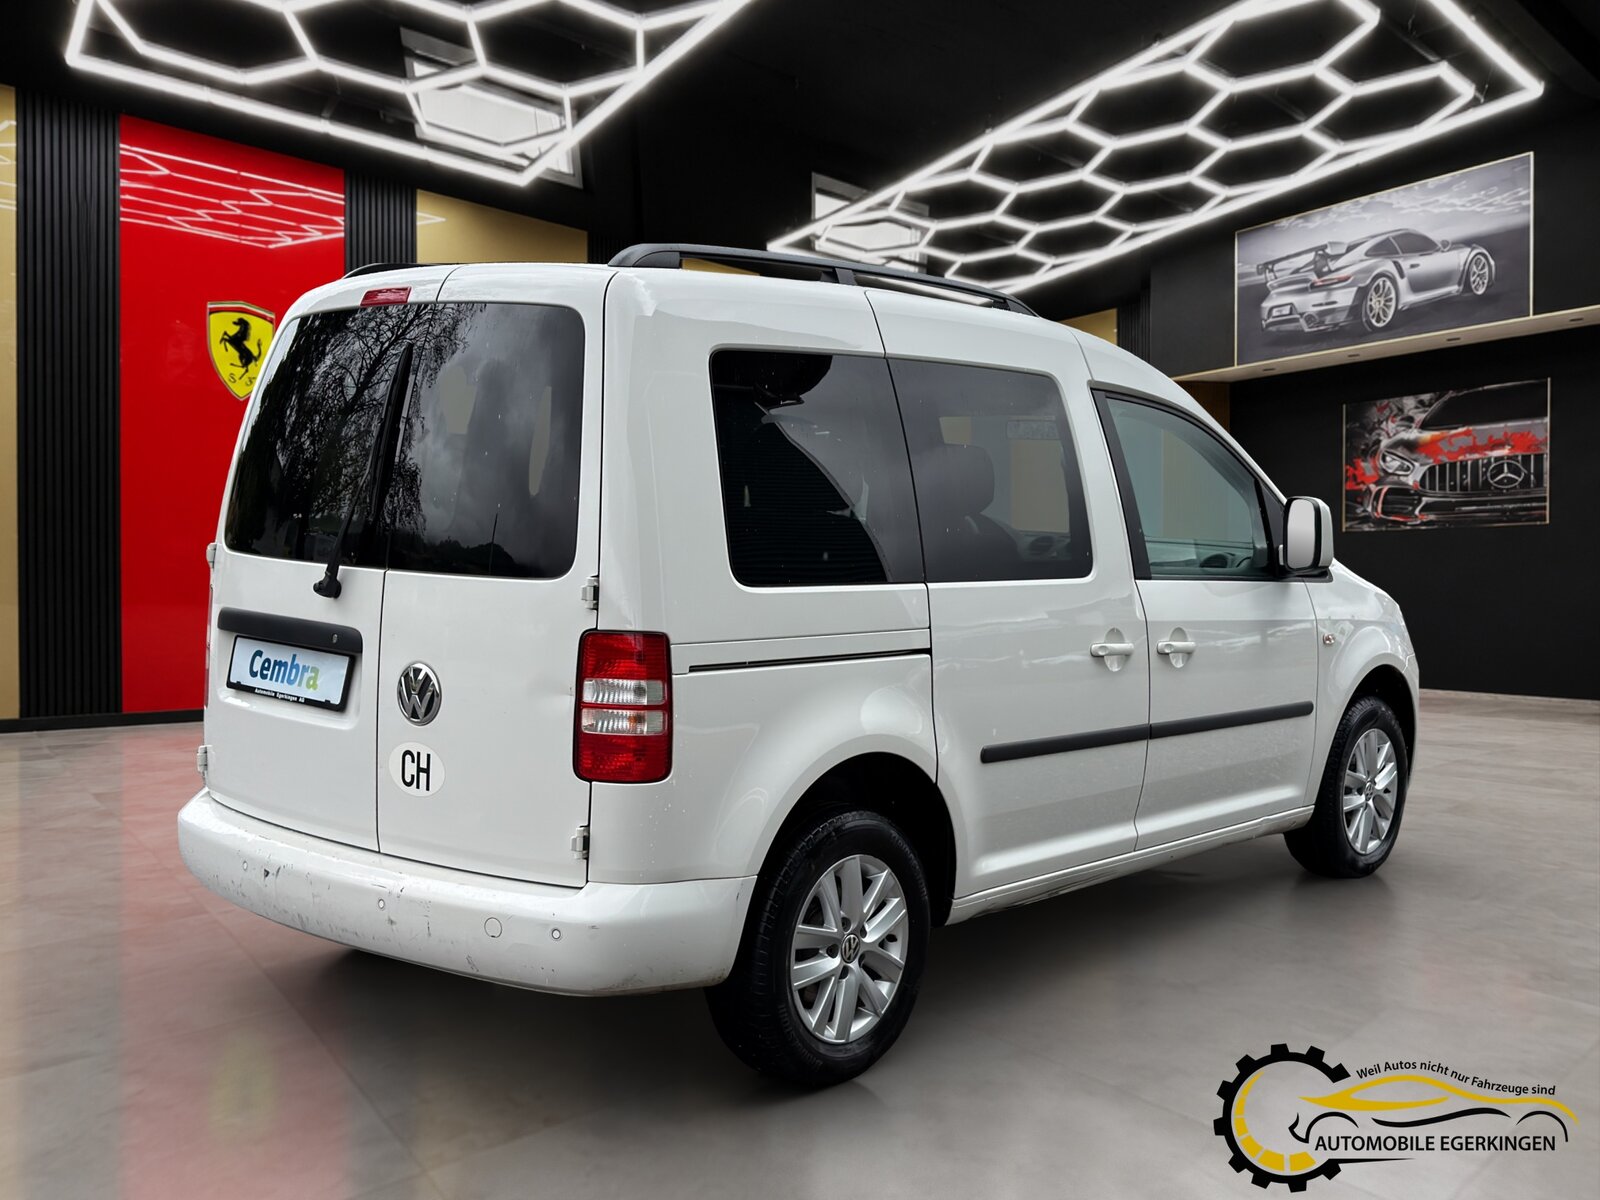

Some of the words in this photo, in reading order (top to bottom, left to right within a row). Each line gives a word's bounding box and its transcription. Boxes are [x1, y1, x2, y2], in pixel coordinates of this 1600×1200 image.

[249, 649, 319, 690] Cembra
[254, 688, 275, 697] Automobile
[401, 749, 431, 791] CH
